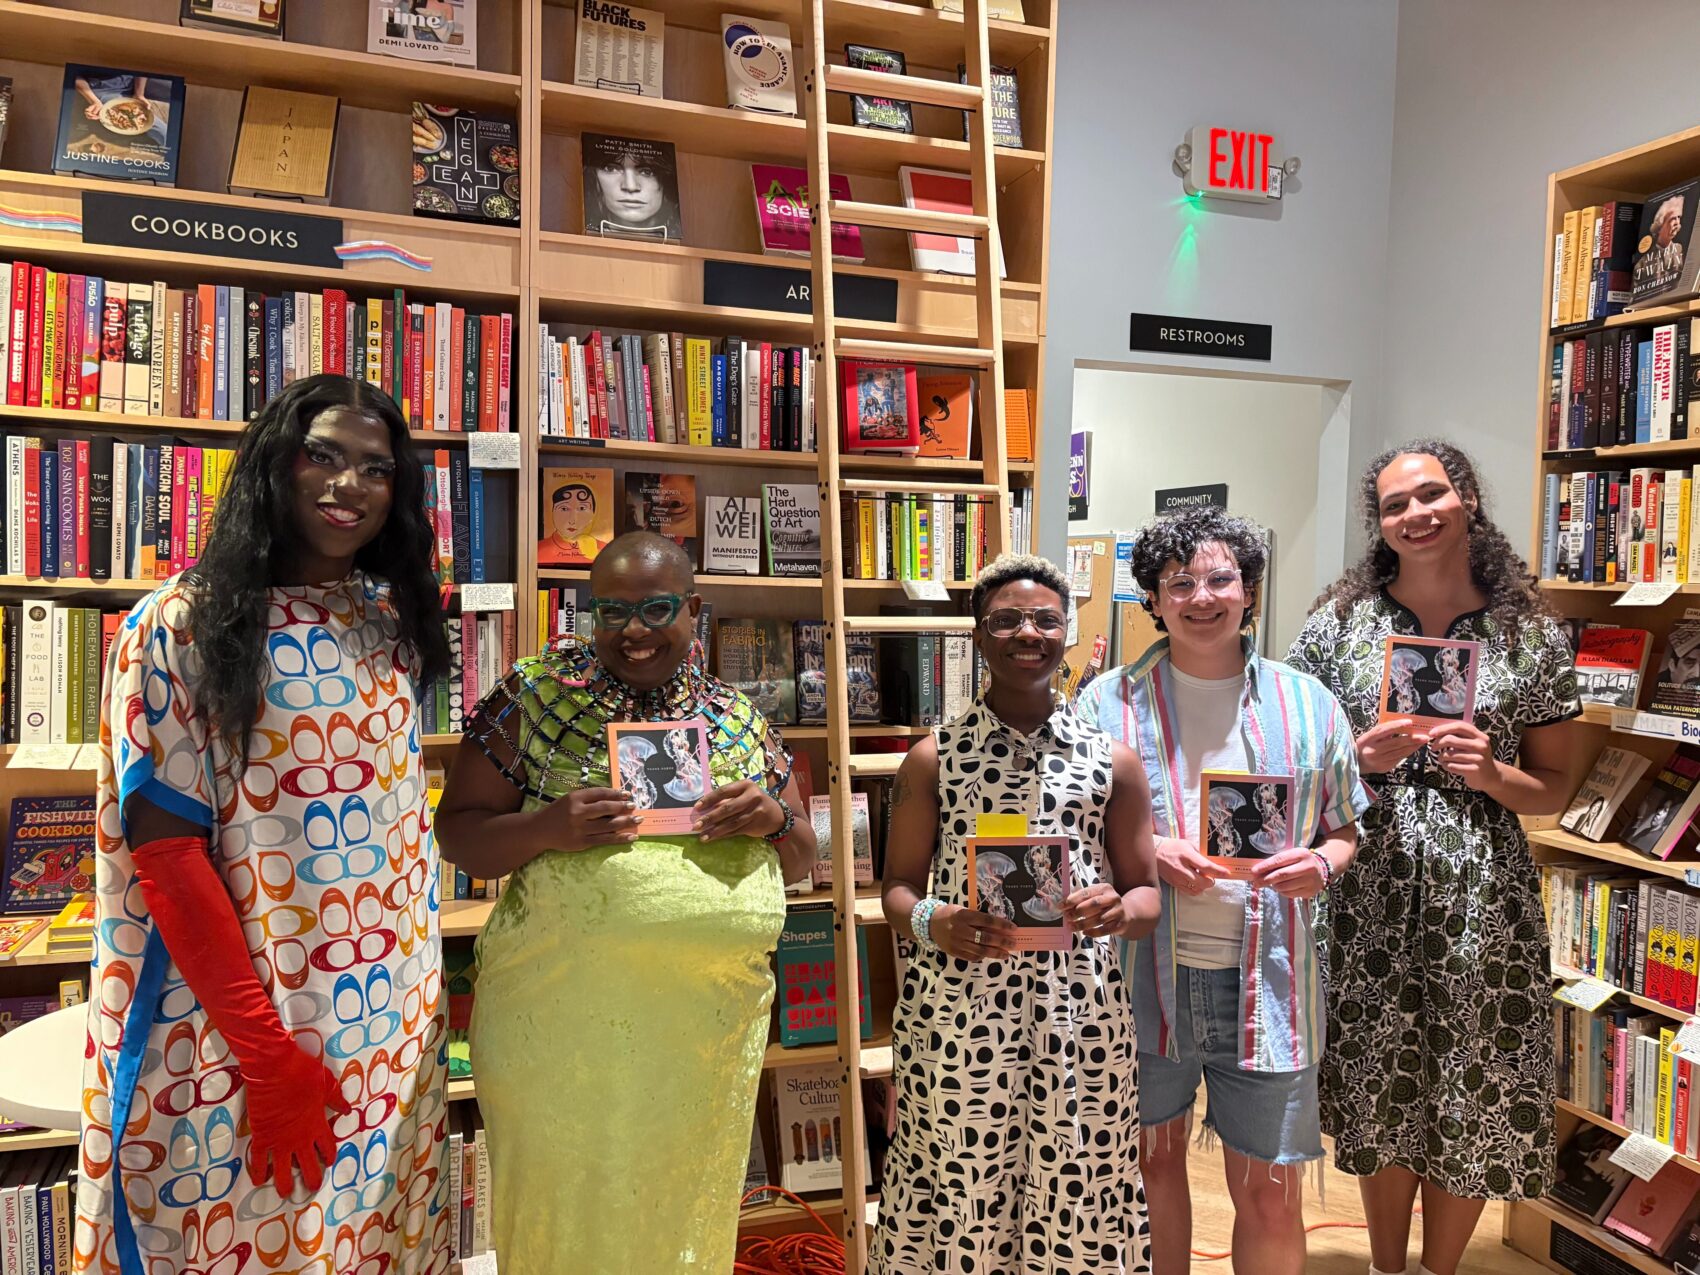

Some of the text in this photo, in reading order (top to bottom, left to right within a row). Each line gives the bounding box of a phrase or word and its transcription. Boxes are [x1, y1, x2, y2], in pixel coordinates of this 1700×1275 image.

[380, 7, 441, 28] Time
[582, 12, 646, 31] FUTURES
[584, 0, 630, 18] BLACK
[404, 42, 439, 51] LOVATO
[995, 91, 1012, 103] THE
[277, 107, 292, 171] JAPAN
[619, 146, 663, 155] GOLDSMITH
[63, 151, 170, 170] JUSTINE COOKS
[459, 121, 473, 200] VEGAN
[1209, 128, 1273, 191] EXIT
[131, 215, 299, 249] COOKBOOKS
[1564, 250, 1572, 274] Albers
[1580, 246, 1588, 271] Albers
[1636, 254, 1682, 280] TWAIN
[88, 281, 97, 306] FUSÃO
[786, 285, 810, 300] AR
[104, 303, 122, 336] pulp
[269, 308, 277, 325] Why
[284, 298, 293, 333] colicchio
[312, 316, 320, 339] SALT
[129, 305, 148, 359] ruffage
[200, 324, 212, 361] by Heart
[248, 327, 261, 359] Chesnok
[1160, 328, 1245, 346] RESTROOMS
[152, 329, 163, 389] TANOREEN
[384, 345, 392, 378] Generation
[414, 342, 422, 373] BRAIDED
[1624, 342, 1632, 380] TYPEWRITER
[1654, 332, 1663, 382] BROKER
[424, 371, 433, 400] Rooza
[605, 349, 615, 400] CHROMATOPIA
[730, 366, 738, 386] Dog's
[1662, 358, 1671, 401] POWER
[62, 447, 72, 540] 108 ASIAN COOKIES
[158, 446, 173, 523] AMERICAN SOUL
[439, 471, 447, 510] Ottolenghi
[767, 486, 789, 497] The
[1632, 475, 1642, 508] CRUMB
[144, 496, 155, 531] BAHARI
[724, 497, 746, 511] AI
[769, 497, 796, 507] Hard
[769, 507, 820, 518] Question
[1166, 494, 1211, 507] COMMUNITY
[1572, 478, 1585, 522] YOUNG KING
[1647, 488, 1656, 526] Wanderlust
[715, 524, 756, 539] WEI
[716, 511, 756, 525] WEI
[770, 518, 803, 528] of Art
[452, 501, 470, 574] FLAVOR
[1595, 515, 1606, 566] JON MEACHAM
[774, 563, 818, 571] Metahaven
[566, 602, 574, 632] JOHN
[722, 627, 756, 635] STORIES
[87, 614, 96, 724] HOMEMADE RAMEN
[804, 653, 820, 669] IN
[448, 619, 462, 733] PASTA BOOK
[17, 825, 96, 838] COOKBOO
[23, 811, 96, 824] FISHWIF
[1651, 899, 1665, 944] COMEDY
[1665, 903, 1679, 948] COMEDY
[1683, 908, 1696, 954] COMEDY
[782, 930, 827, 944] Shapes
[787, 1077, 840, 1092] Skateboa
[800, 1092, 840, 1105] Cultur
[449, 1139, 460, 1197] TARTINE
[477, 1143, 486, 1208] GREAT BAKES
[5, 1197, 15, 1226] BAKING
[24, 1196, 33, 1225] BAKING
[42, 1216, 51, 1260] HOLLYWOOD
[57, 1217, 67, 1267] MORNING
